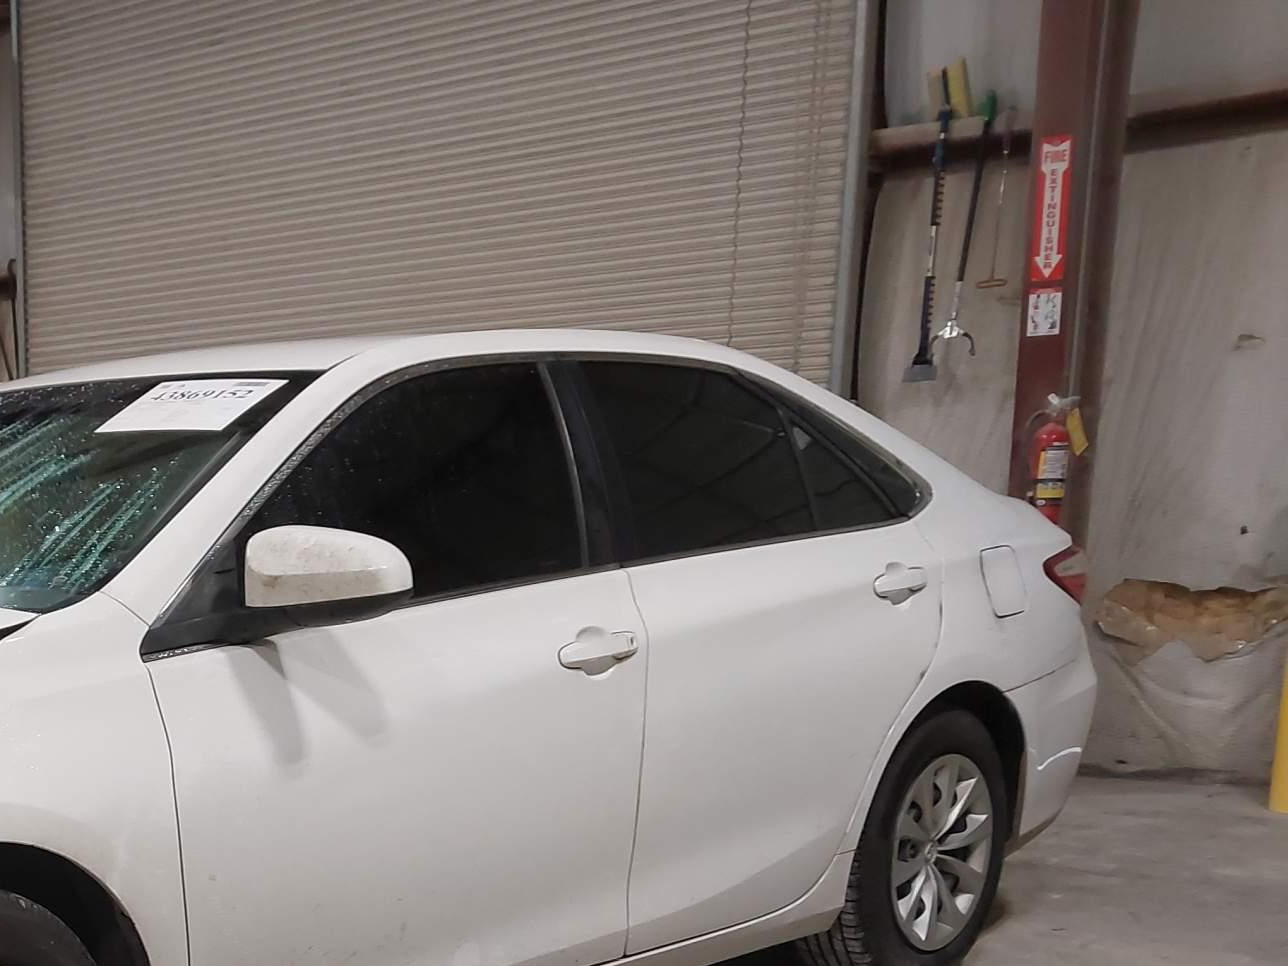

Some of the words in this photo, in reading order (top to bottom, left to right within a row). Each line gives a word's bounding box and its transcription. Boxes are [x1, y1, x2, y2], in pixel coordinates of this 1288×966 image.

[1044, 149, 1068, 163] FIRE
[1042, 168, 1058, 270] EXTINGUISHER
[150, 389, 254, 401] 43869152
